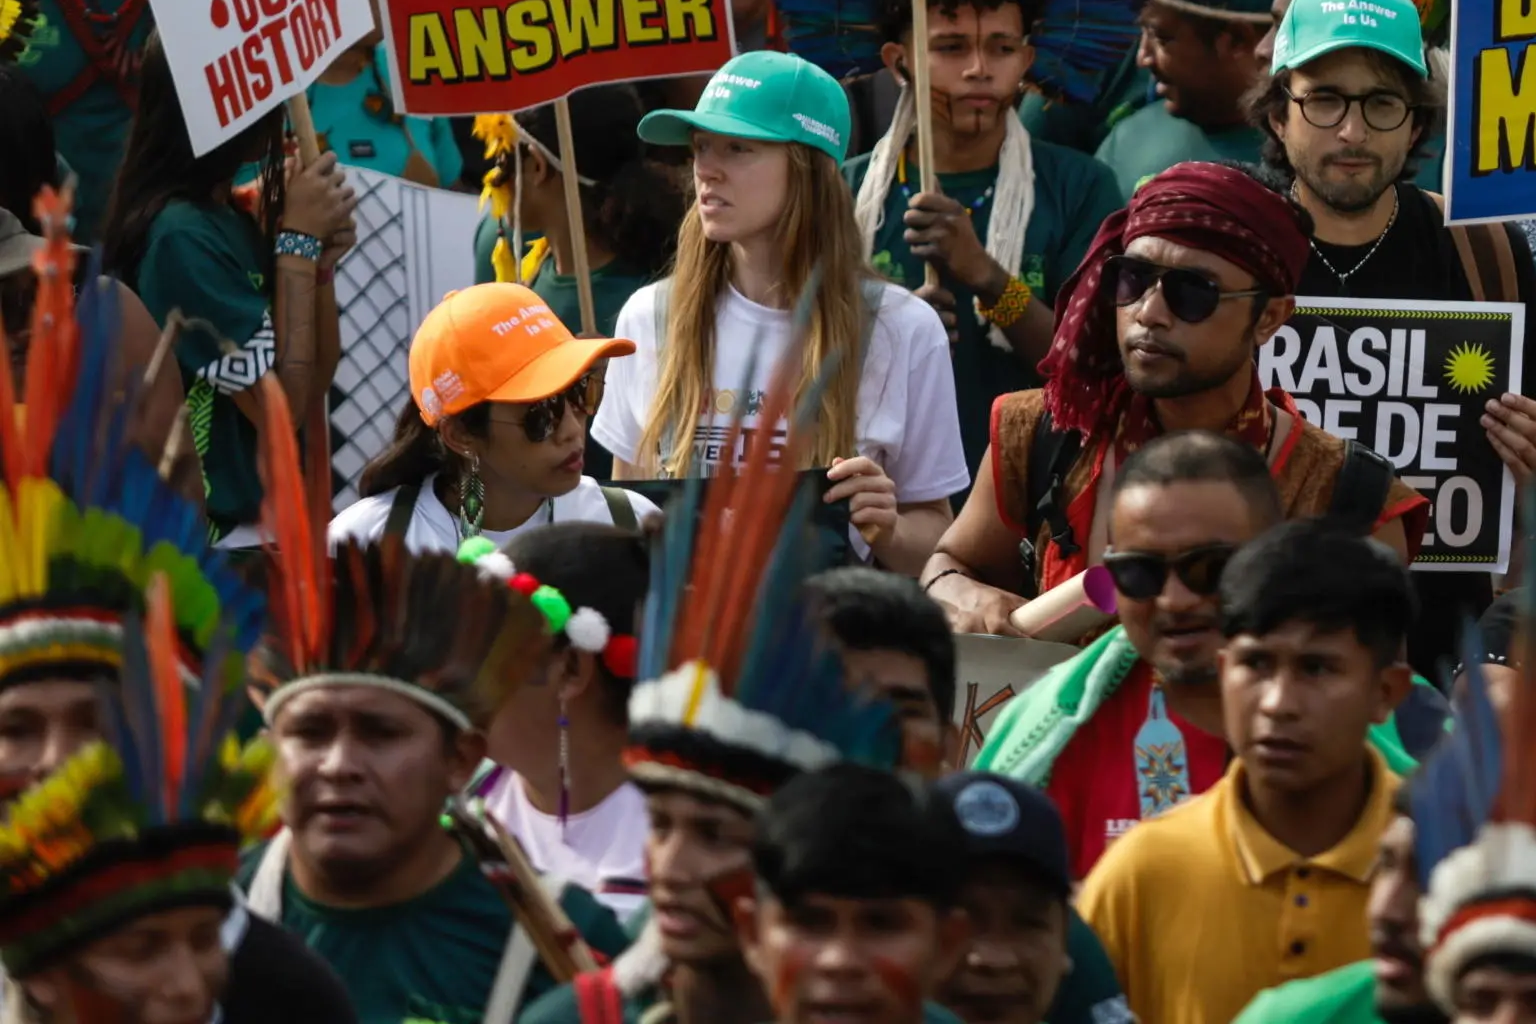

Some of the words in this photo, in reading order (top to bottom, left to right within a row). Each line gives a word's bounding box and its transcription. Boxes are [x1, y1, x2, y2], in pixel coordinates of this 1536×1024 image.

[1320, 1, 1346, 14] The
[1360, 12, 1378, 27] Us
[715, 86, 731, 99] Us
[491, 316, 521, 337] The
[1257, 324, 1439, 399] RASIL
[1374, 401, 1461, 471] DE
